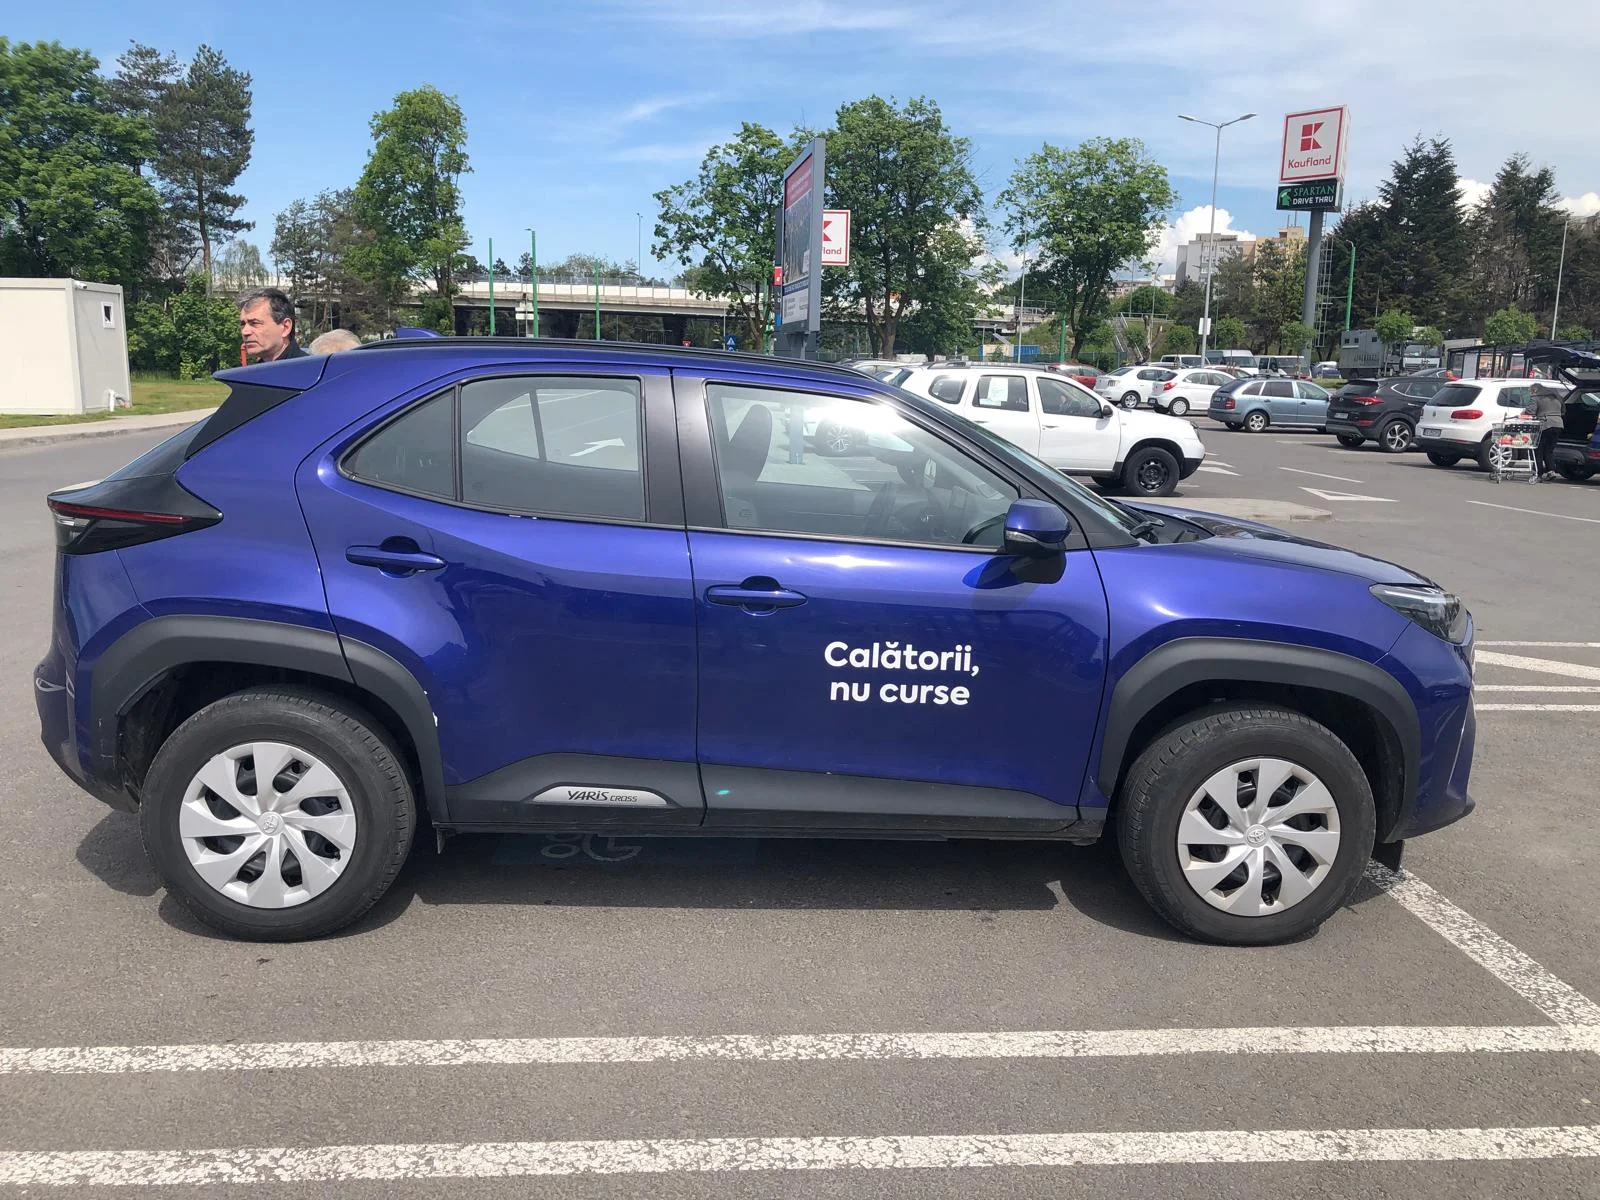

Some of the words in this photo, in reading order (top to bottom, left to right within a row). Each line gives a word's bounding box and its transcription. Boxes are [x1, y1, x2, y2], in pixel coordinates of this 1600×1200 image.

[1288, 155, 1331, 169] Kaufland
[1293, 186, 1335, 197] SPARTAN
[1292, 197, 1313, 205] DRIVE
[823, 247, 842, 255] land
[824, 641, 979, 677] Calătorii,
[830, 681, 870, 702] nu
[879, 683, 970, 706] curse
[610, 795, 638, 803] CROSS
